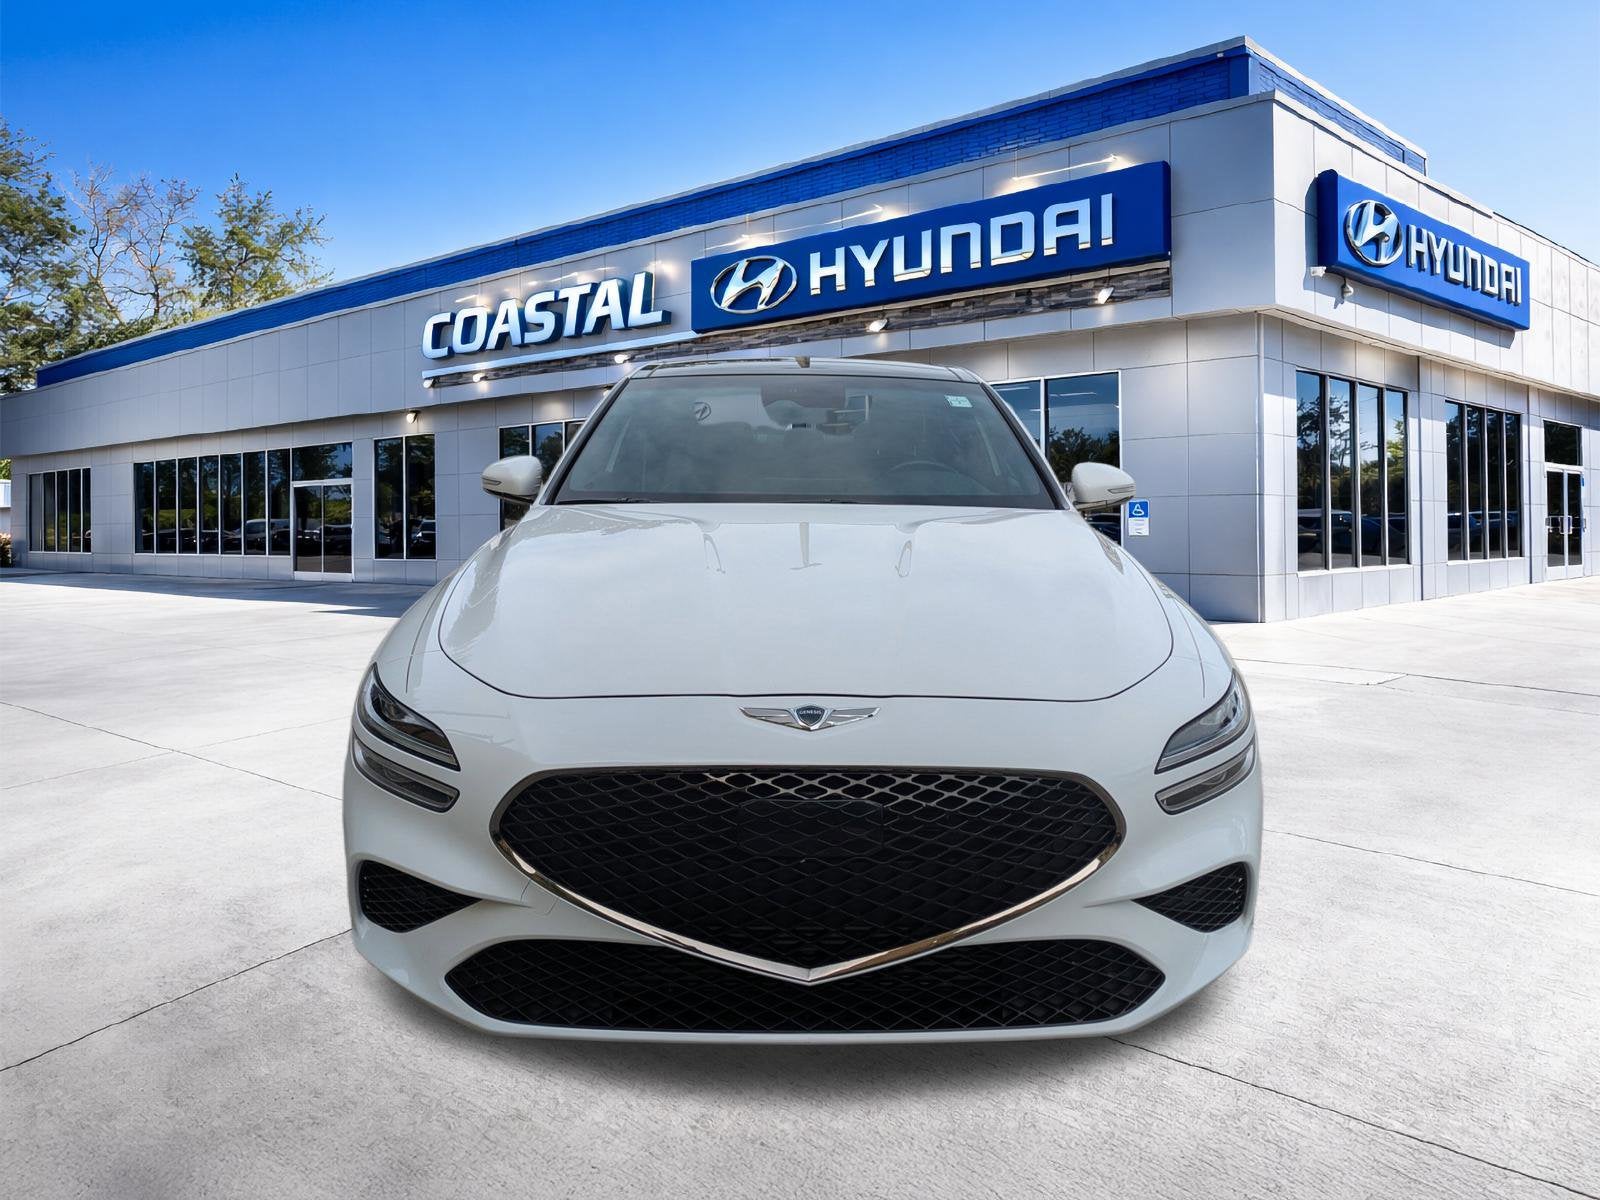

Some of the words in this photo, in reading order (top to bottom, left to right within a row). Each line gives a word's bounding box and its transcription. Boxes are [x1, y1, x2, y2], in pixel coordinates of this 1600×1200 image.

[809, 193, 1114, 296] HYUNDAI
[1406, 224, 1522, 306] HYUNDAI
[422, 271, 669, 360] COASTAL
